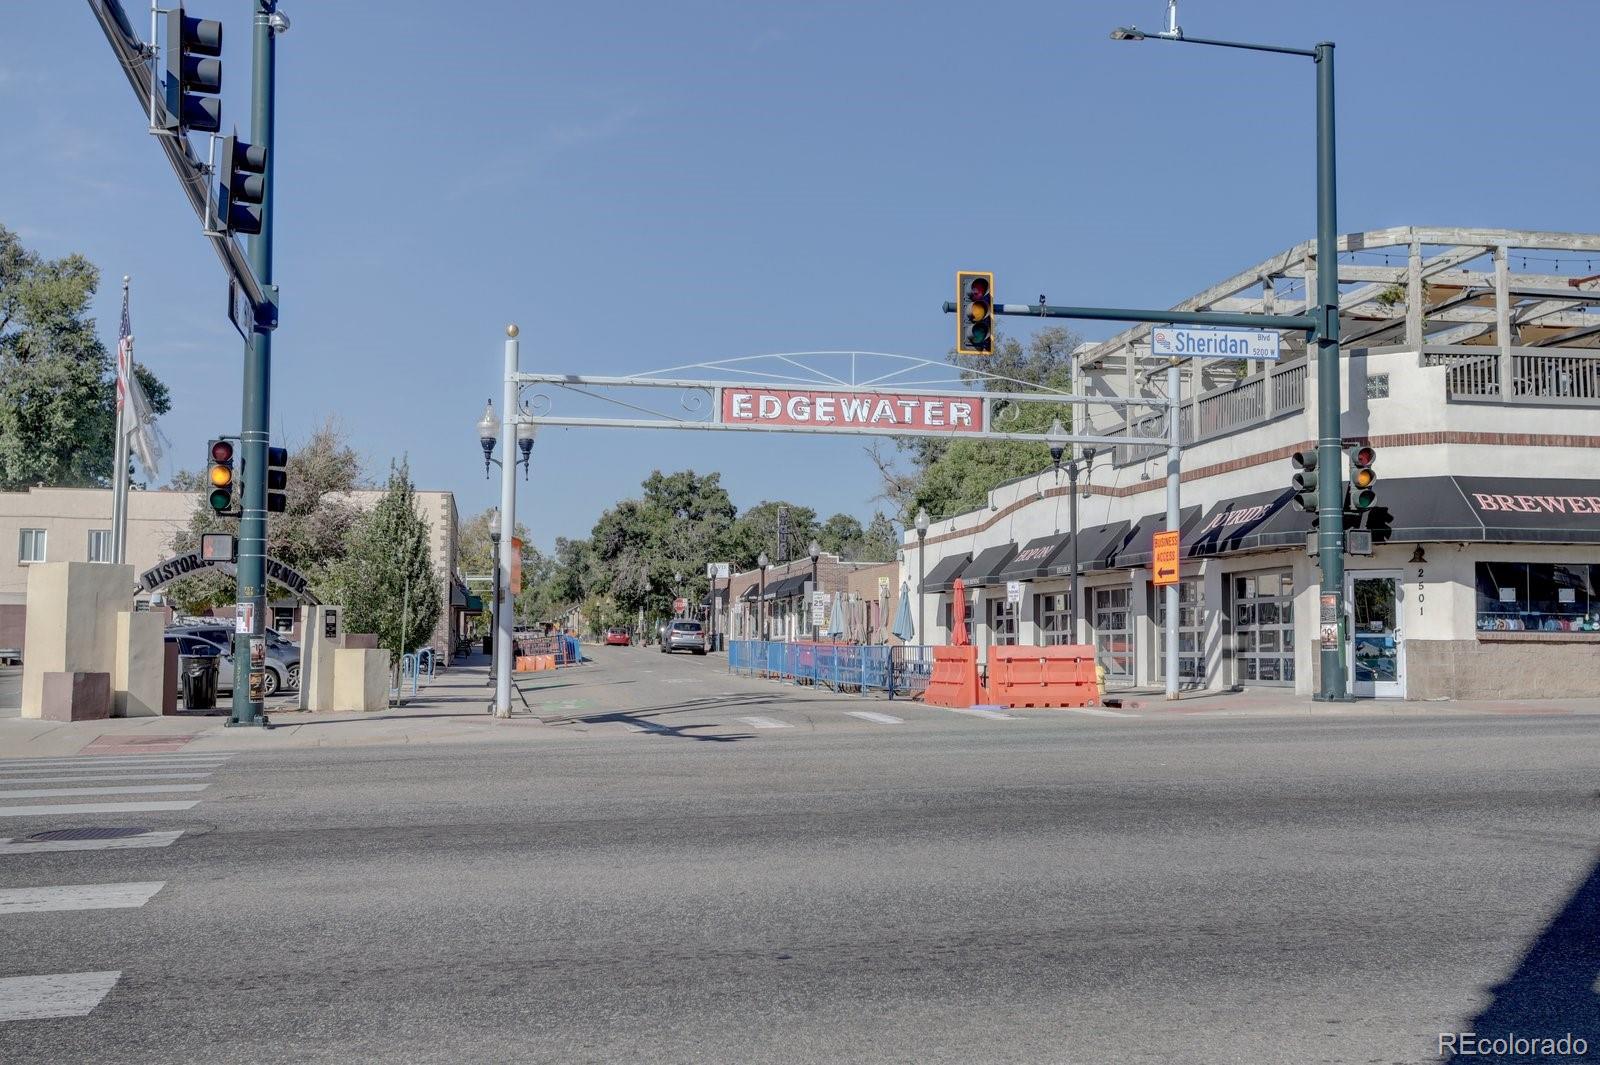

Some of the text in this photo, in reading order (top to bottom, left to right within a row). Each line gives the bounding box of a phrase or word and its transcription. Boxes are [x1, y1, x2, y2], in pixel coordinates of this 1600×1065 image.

[1175, 331, 1249, 355] Sheridan
[1257, 333, 1271, 341] Blvd
[1252, 348, 1269, 356] 5200
[732, 393, 973, 426] EDGEWATER
[1200, 503, 1275, 534] JOYRIDE
[1154, 535, 1178, 548] BUSINESS
[1156, 551, 1176, 562] ACCESS
[266, 558, 308, 594] VENUE
